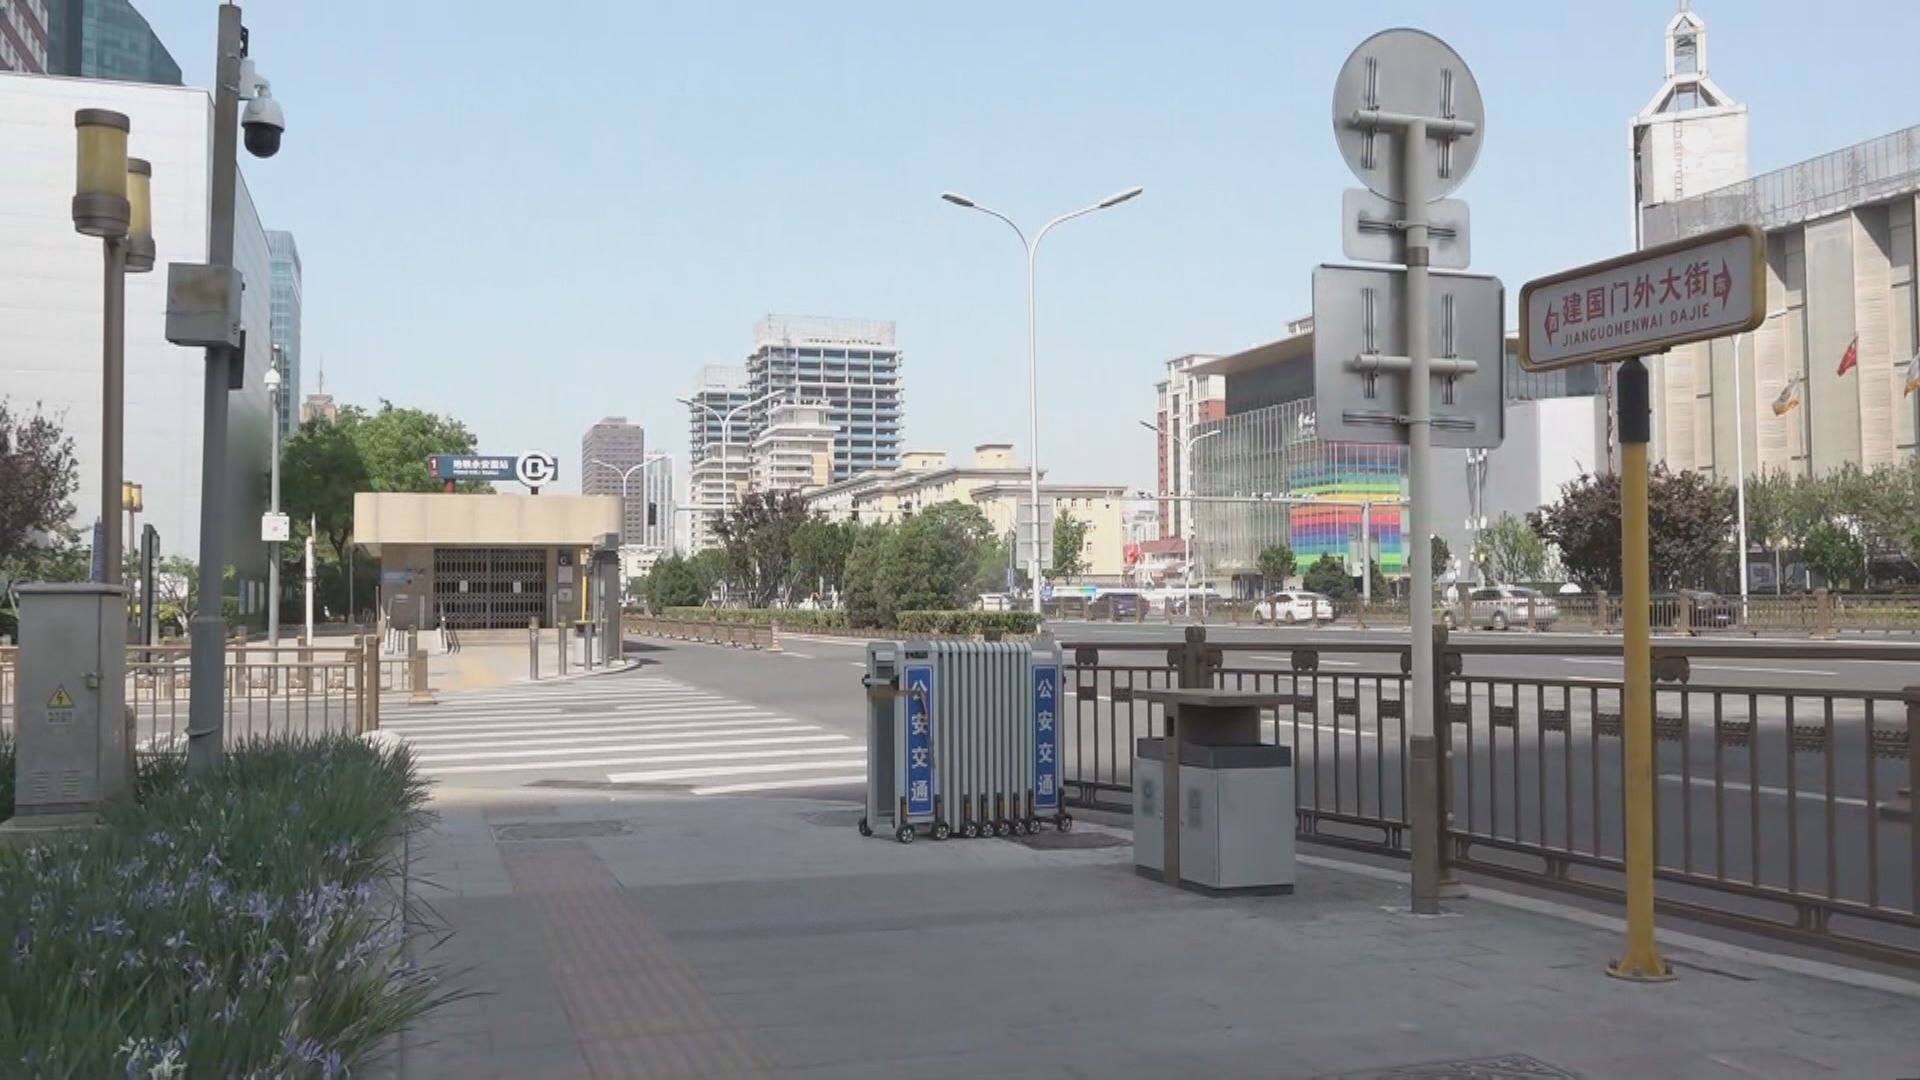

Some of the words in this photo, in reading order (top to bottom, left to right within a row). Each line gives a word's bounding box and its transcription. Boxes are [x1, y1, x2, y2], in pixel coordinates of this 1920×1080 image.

[1562, 261, 1710, 326] 建国门外大街
[1562, 315, 1663, 347] JIANGUOMENWAI
[1670, 302, 1710, 326] DAJIE
[911, 679, 929, 801] 公安交通
[1037, 678, 1054, 795] 公安交通
